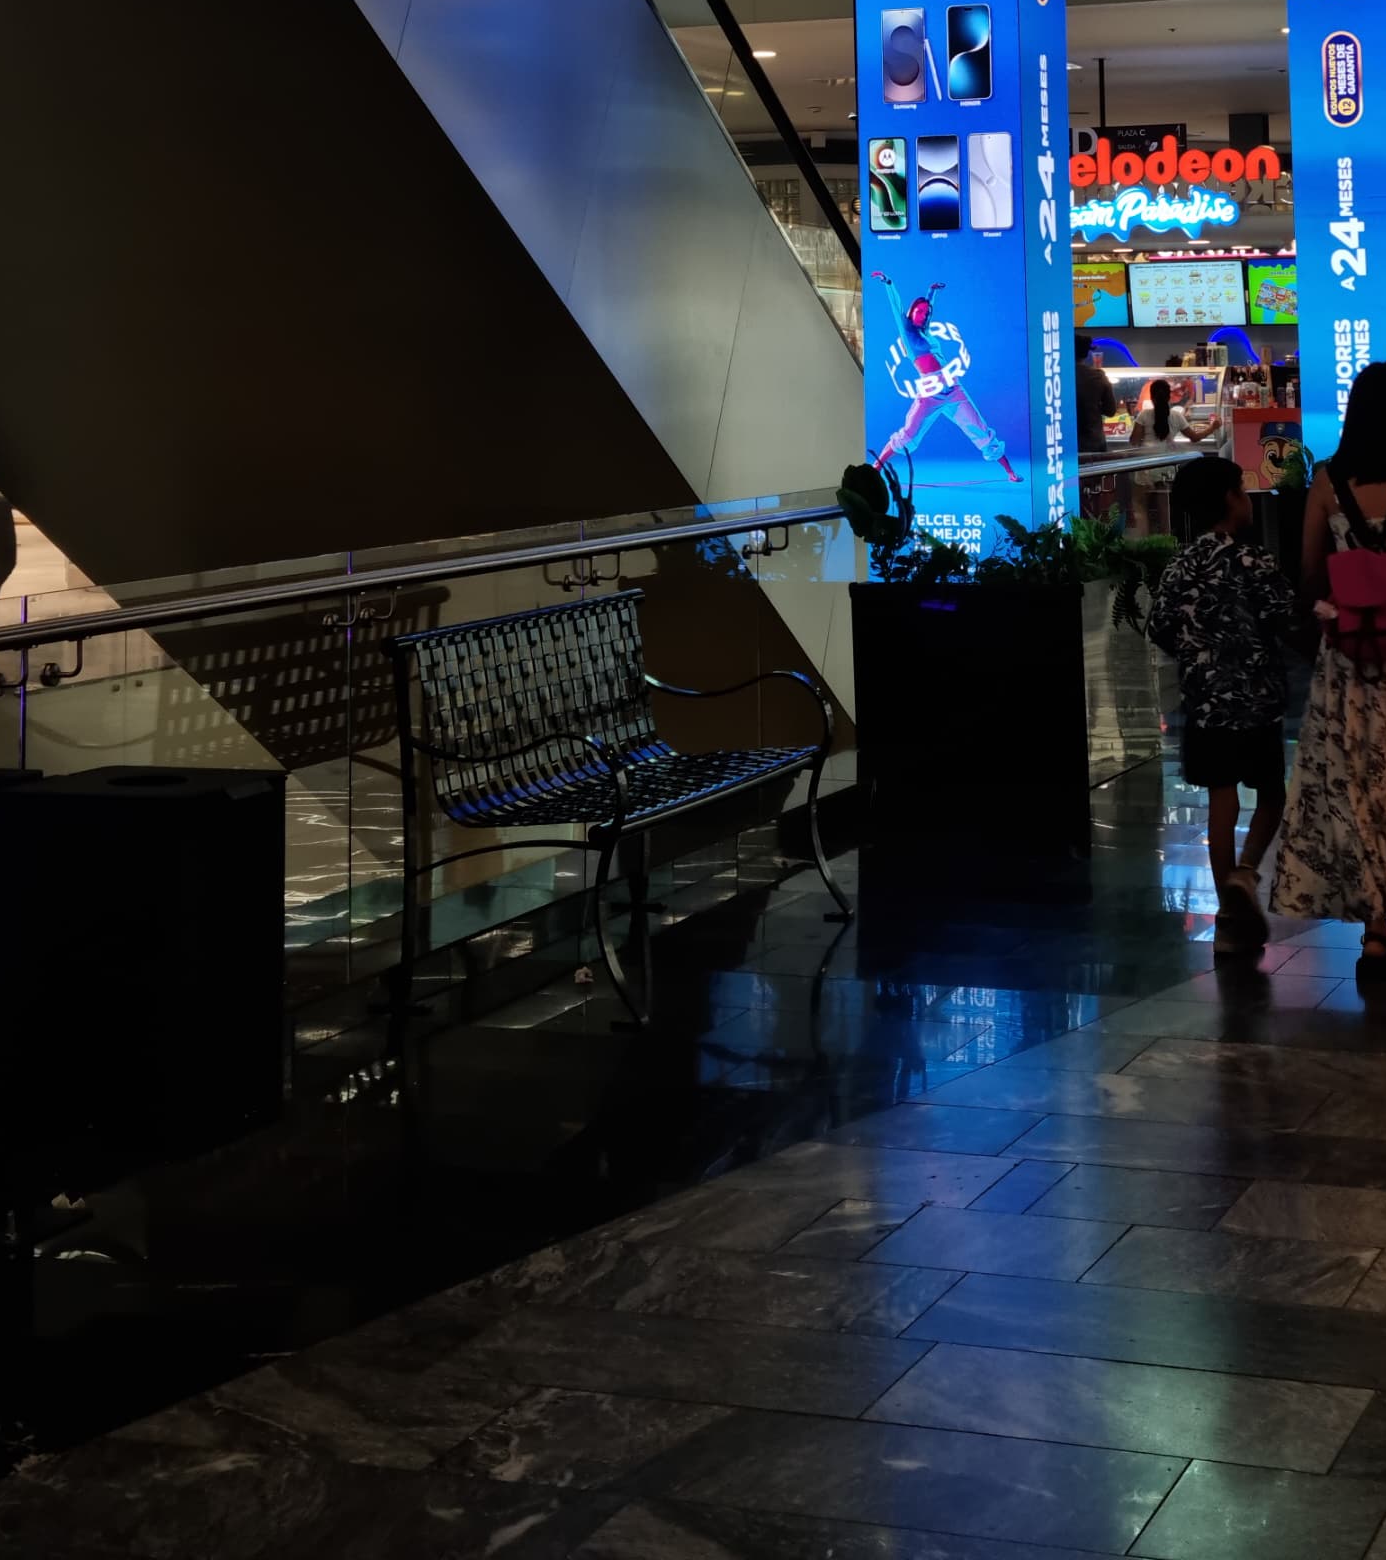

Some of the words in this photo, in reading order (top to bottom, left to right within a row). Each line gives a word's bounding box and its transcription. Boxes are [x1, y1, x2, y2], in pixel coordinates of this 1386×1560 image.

[1328, 43, 1337, 74] NUEVOS
[1336, 43, 1346, 58] DE
[1345, 43, 1356, 95] GARANTÍA
[1329, 75, 1338, 116] EQUIPOS
[1337, 58, 1347, 96] MESES
[1039, 53, 1050, 147] MESES
[1343, 100, 1352, 112] 12
[1072, 127, 1099, 155] D
[1117, 130, 1138, 138] PLAZA
[1139, 128, 1147, 137] C
[1037, 153, 1057, 243] 24
[1337, 157, 1354, 217] MESES
[1117, 188, 1235, 231] Paradise
[1329, 217, 1367, 276] 24
[1042, 311, 1056, 475] MEJORES
[1050, 311, 1064, 526] MARTPHONES
[932, 527, 982, 541] MEJOR
